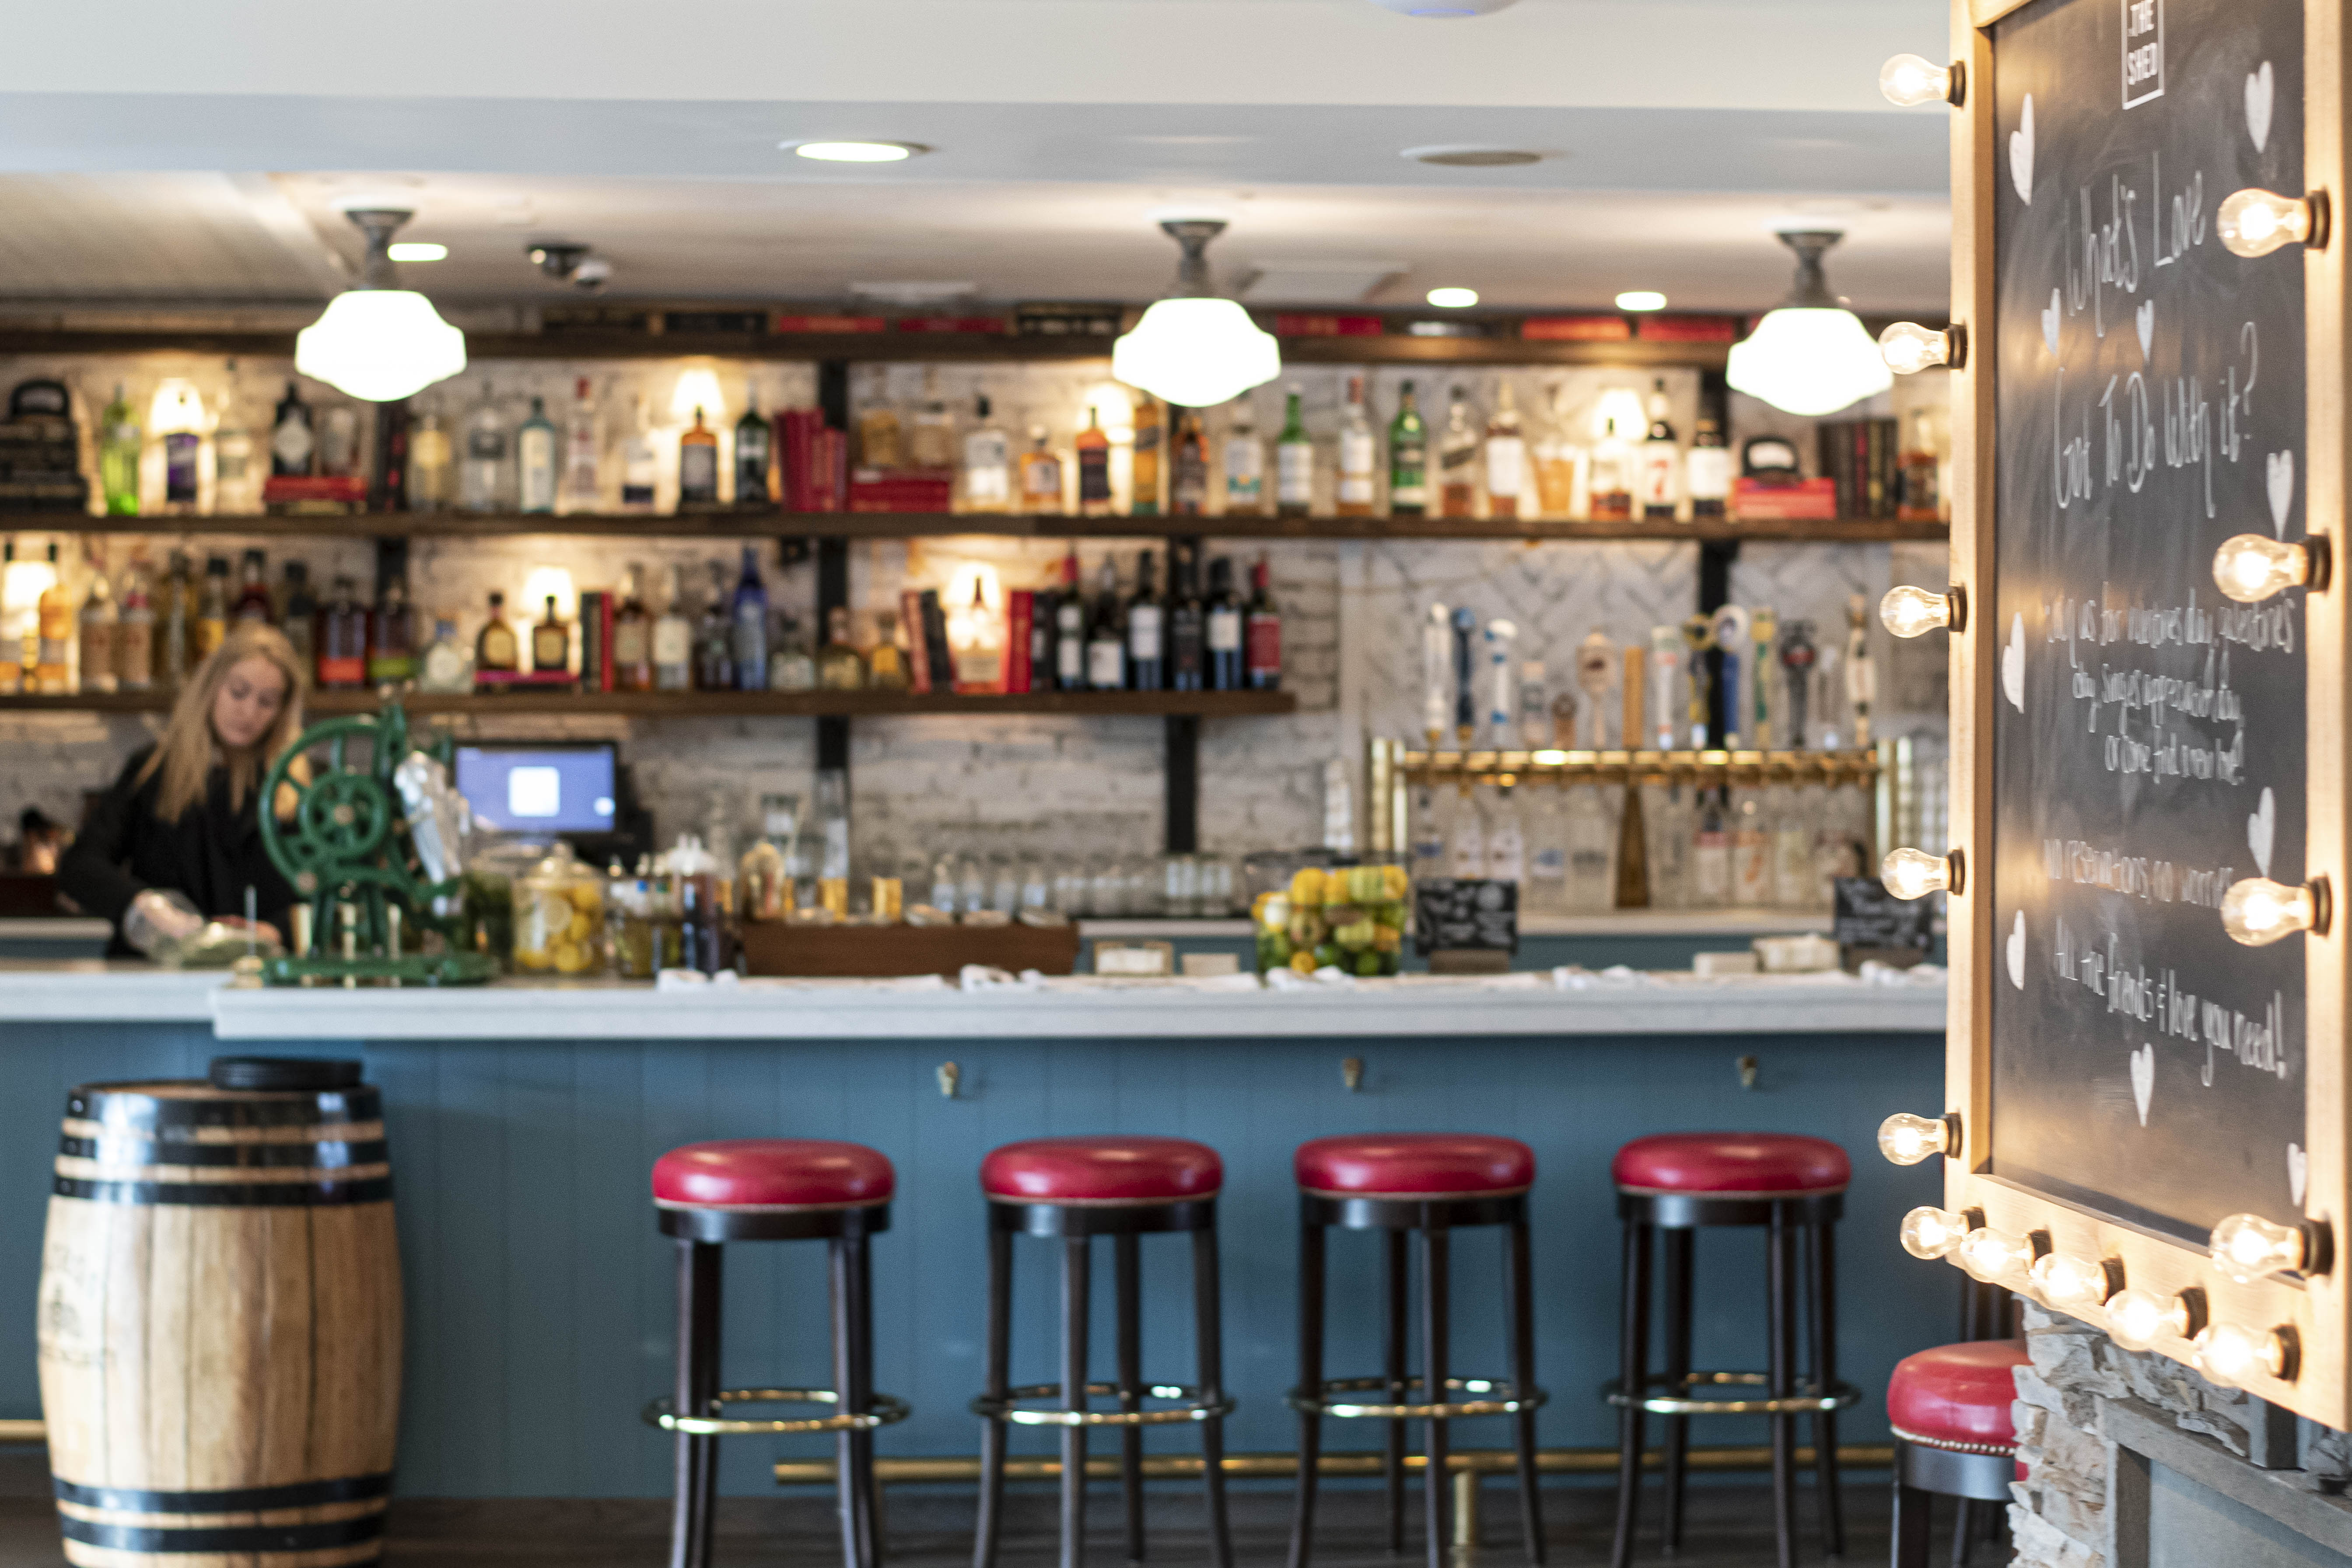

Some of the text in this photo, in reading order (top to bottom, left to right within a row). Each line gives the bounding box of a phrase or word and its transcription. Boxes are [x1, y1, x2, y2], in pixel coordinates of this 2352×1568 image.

[2128, 0, 2154, 36] THE
[2128, 42, 2157, 85] SHED
[2153, 151, 2206, 267] Love
[2054, 367, 2093, 509] Got
[2099, 374, 2122, 487] To
[2125, 371, 2155, 493] Do
